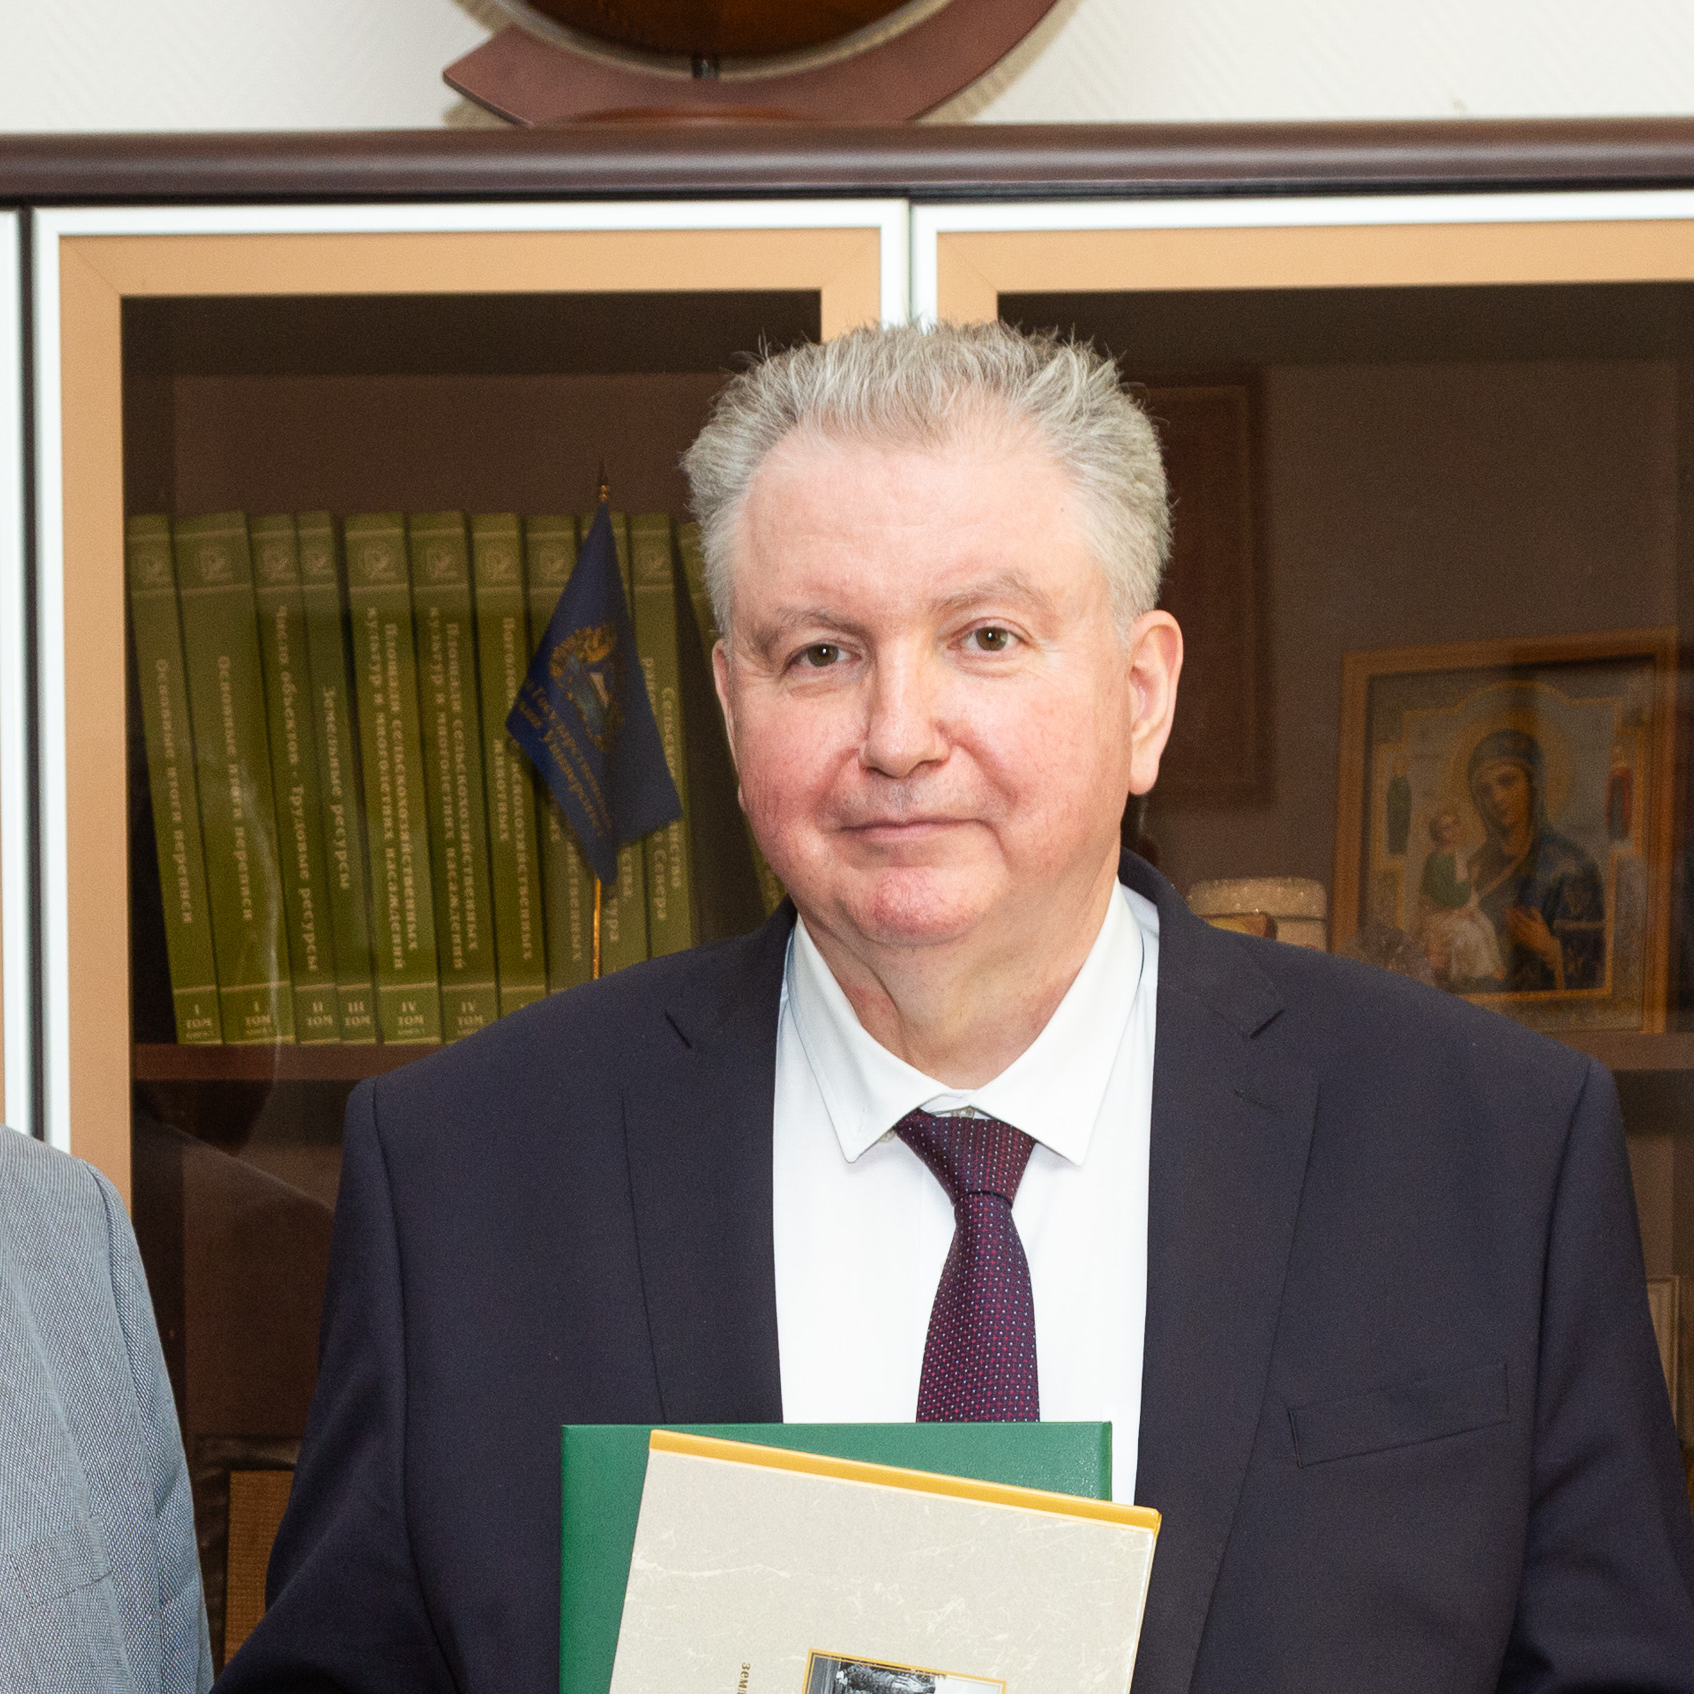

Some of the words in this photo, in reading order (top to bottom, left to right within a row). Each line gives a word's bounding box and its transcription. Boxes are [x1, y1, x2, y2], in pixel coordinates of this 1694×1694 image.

[275, 606, 289, 665] Число
[384, 624, 402, 712] Площади
[429, 607, 444, 687] культур
[445, 623, 463, 712] Площади
[503, 617, 519, 708] Поголов
[155, 659, 177, 759] Основные
[217, 656, 238, 756] Основные
[281, 672, 301, 764] объектов
[322, 687, 342, 796] Земельные
[166, 767, 183, 822] итоги
[227, 764, 245, 821] итоги
[367, 607, 383, 687] культур
[375, 712, 393, 839] многолетних
[385, 848, 405, 969] насаждений
[437, 712, 454, 839] многолетних
[493, 739, 511, 842] животных
[173, 830, 194, 924] переписи
[235, 827, 254, 920] переписи
[290, 784, 312, 879] Трудовые
[330, 804, 351, 889] ресурсы
[391, 719, 419, 950] сельскохозяйственных
[301, 888, 320, 971] ресурсы
[445, 848, 466, 969] насаждений
[653, 849, 668, 920] Севера
